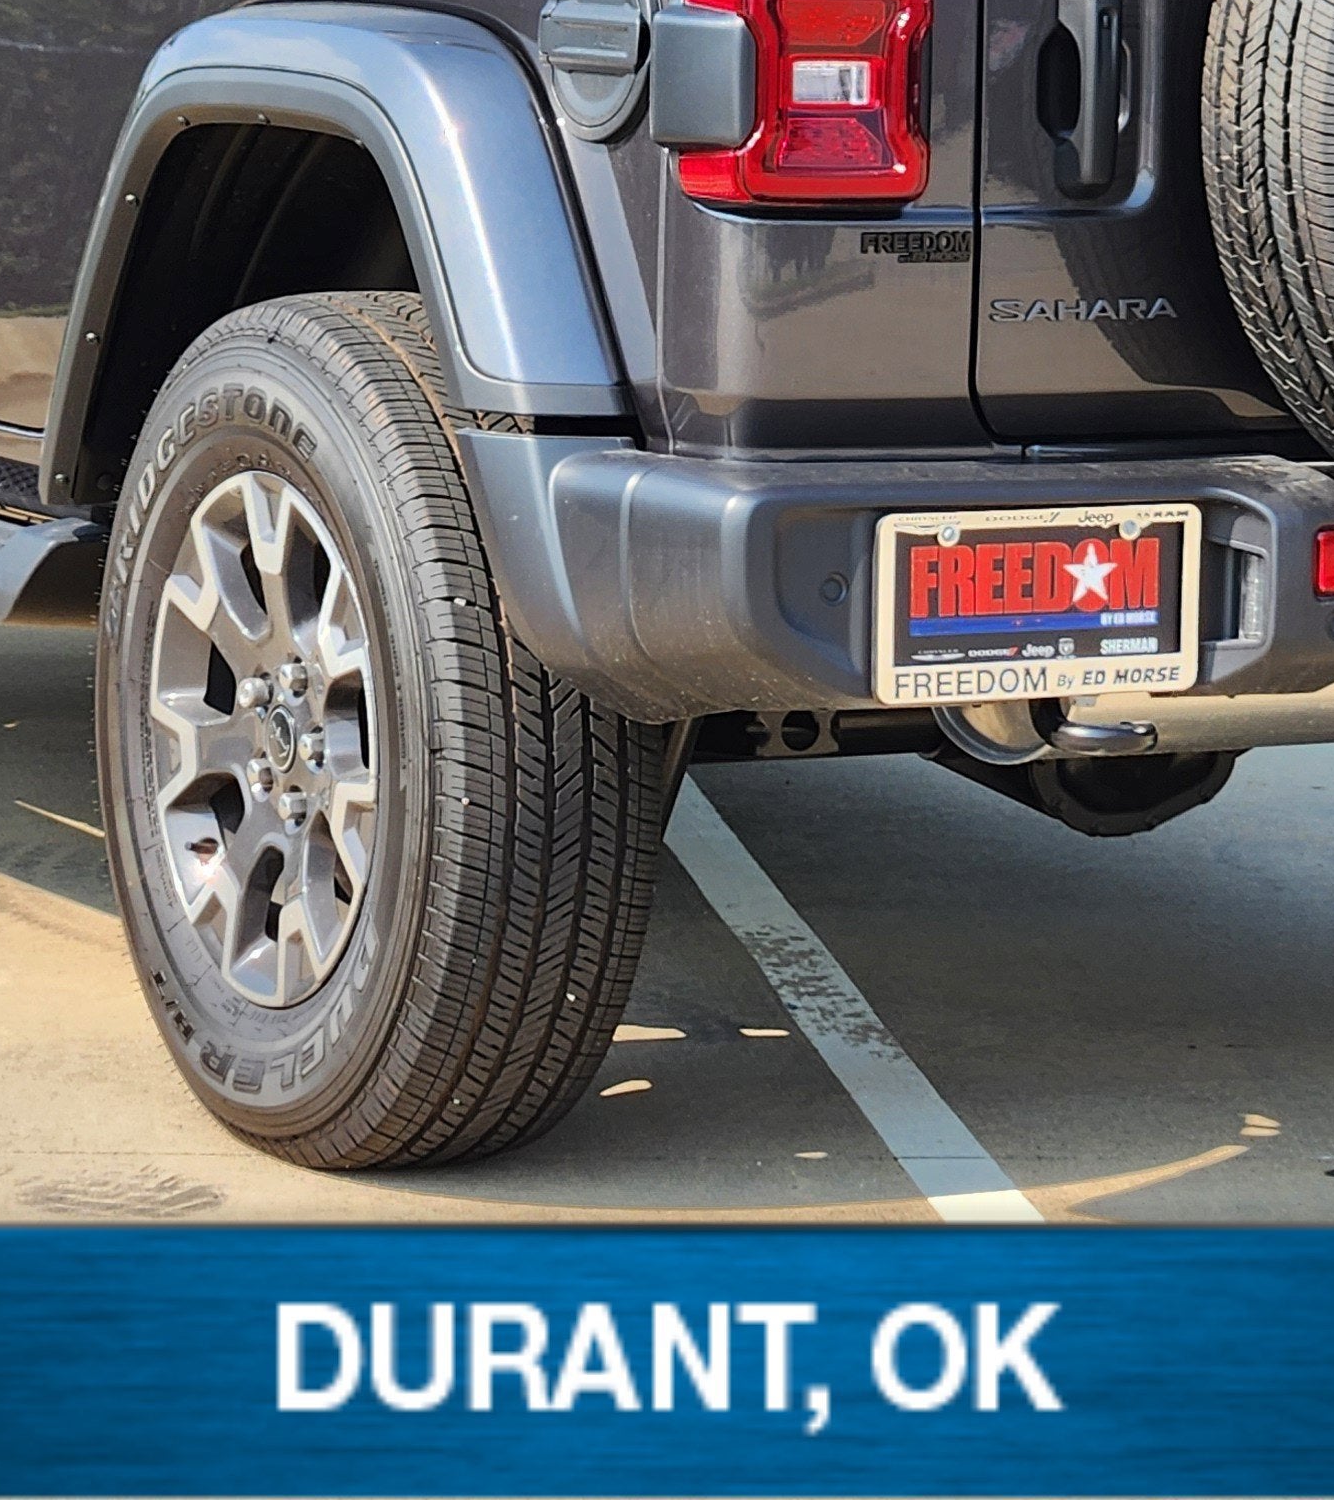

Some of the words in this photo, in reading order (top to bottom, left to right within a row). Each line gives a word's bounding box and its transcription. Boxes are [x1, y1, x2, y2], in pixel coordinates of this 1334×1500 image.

[861, 231, 971, 253] FREEDOM
[989, 297, 1178, 323] SAHARA
[1078, 510, 1114, 524] Jeep
[910, 537, 1160, 618] FREEDOM
[1021, 643, 1055, 658] Jeep
[1100, 636, 1159, 656] SHERMAN
[894, 667, 1048, 699] FREEDOM
[1082, 669, 1106, 686] ED
[1113, 665, 1181, 684] MORSE
[199, 912, 380, 1095] DUELER
